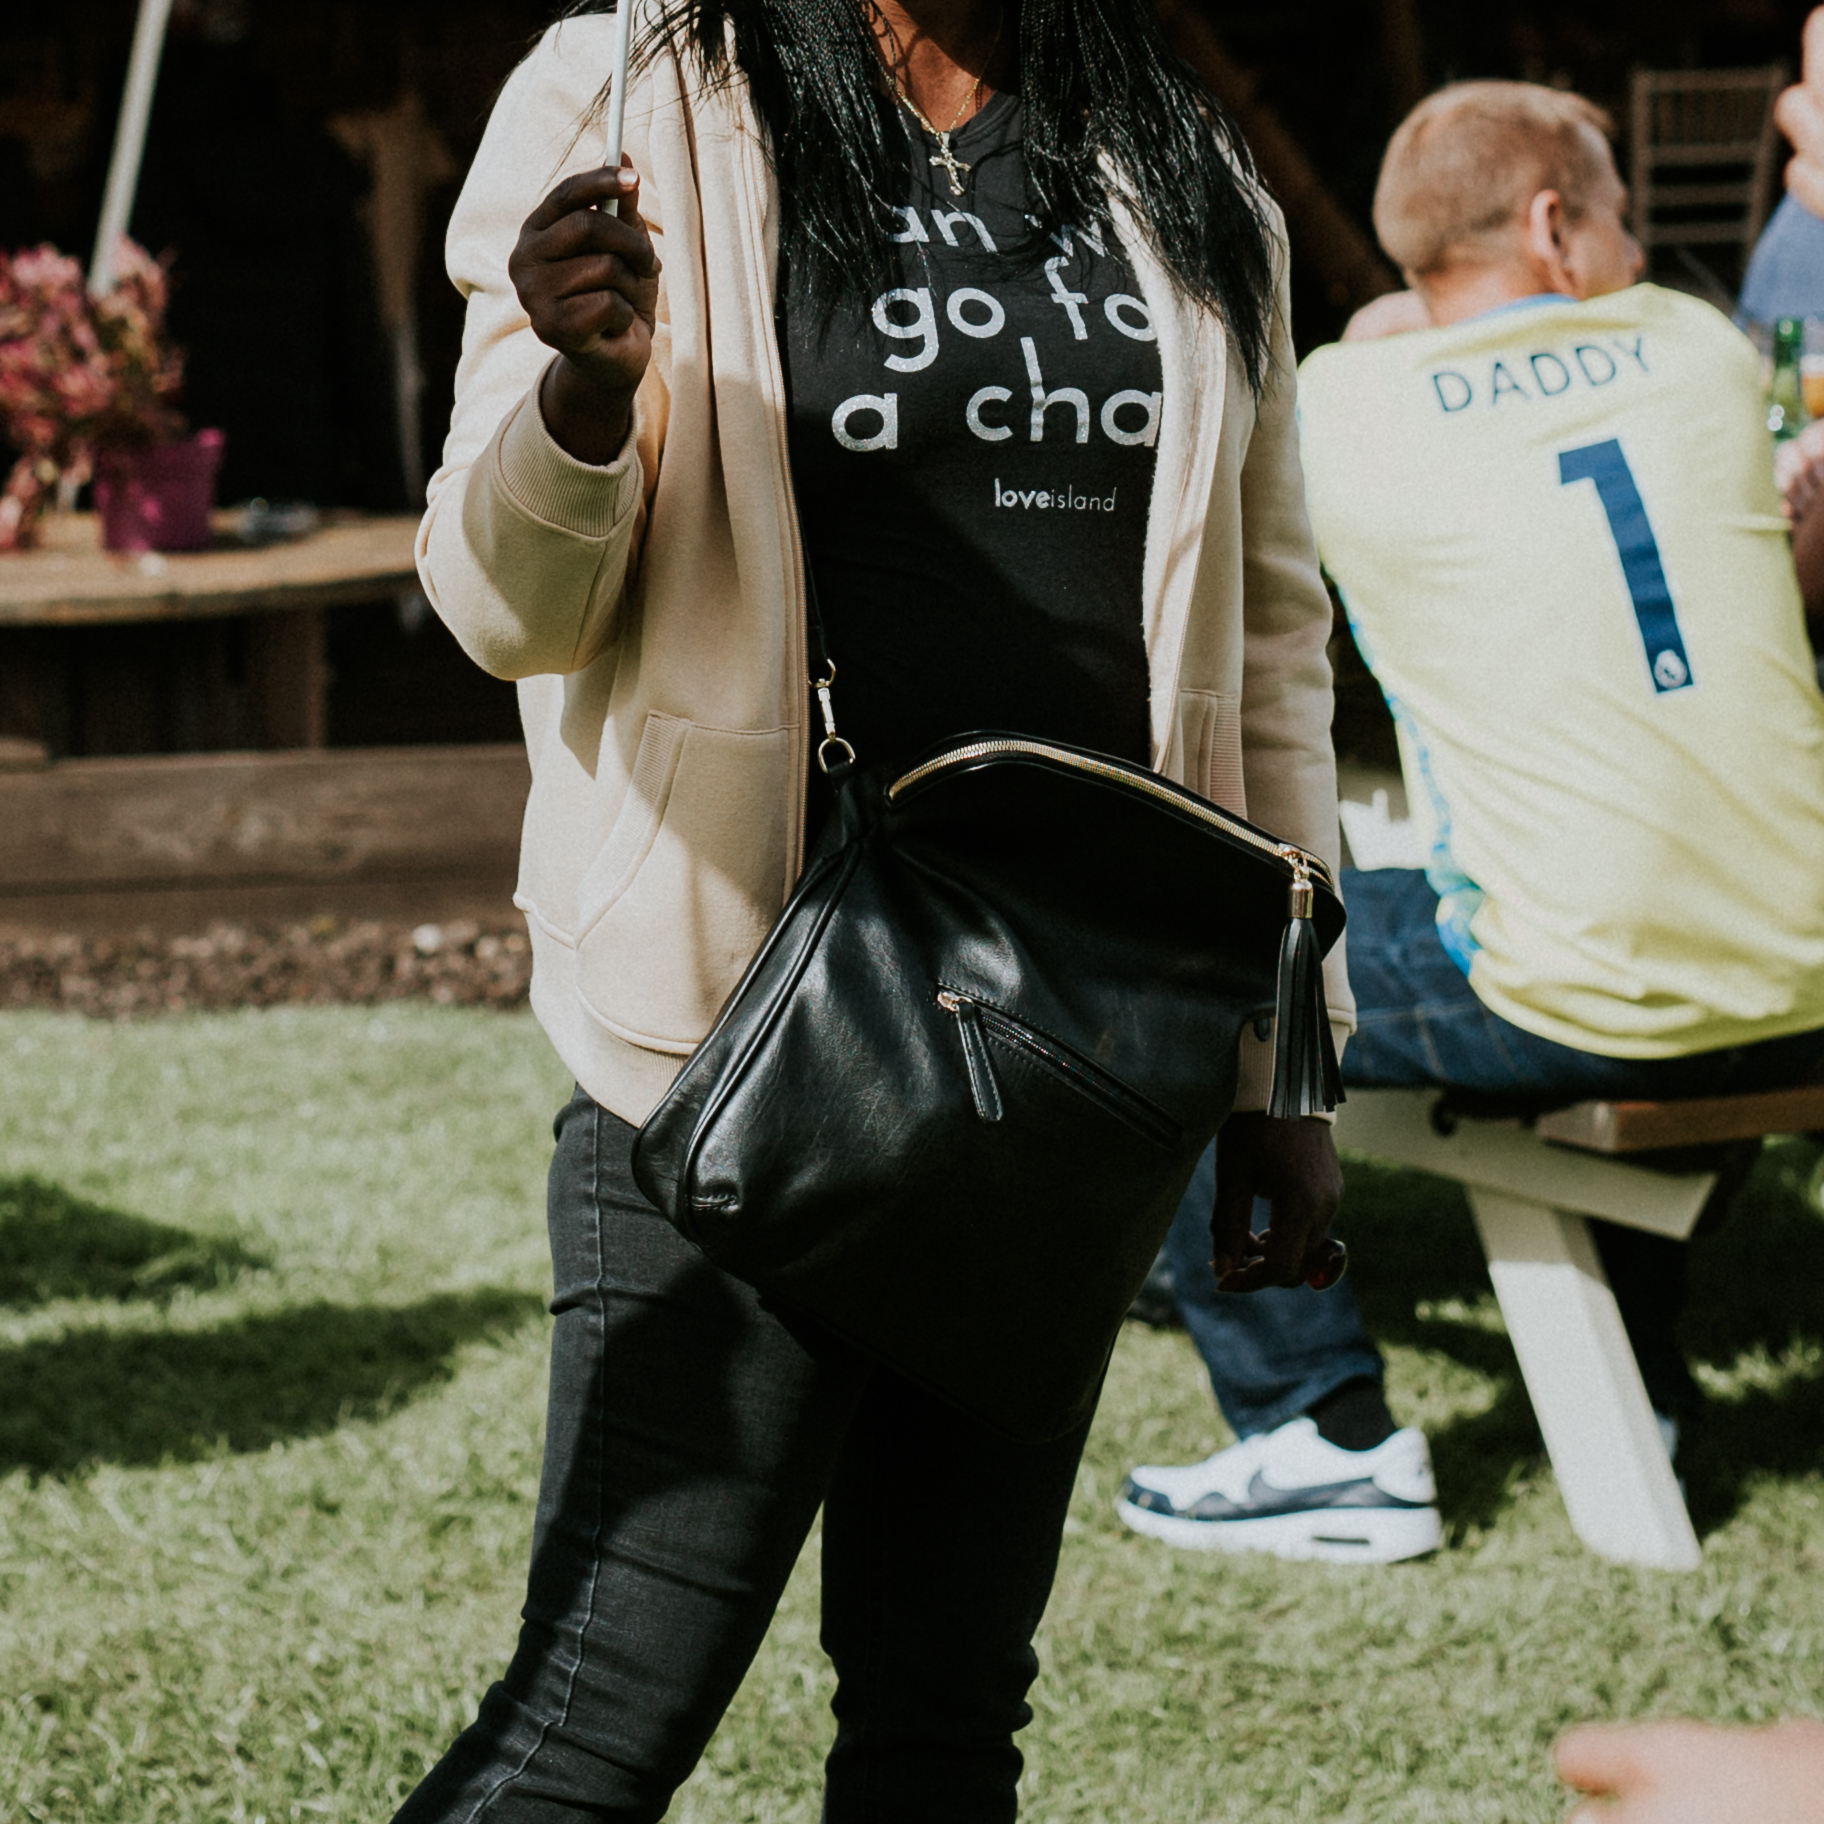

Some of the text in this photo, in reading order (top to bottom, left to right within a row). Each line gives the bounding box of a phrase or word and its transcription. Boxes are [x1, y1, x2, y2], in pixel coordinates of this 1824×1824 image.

[871, 287, 1006, 373] go
[831, 336, 1163, 452] a cha
[1432, 335, 1650, 413] DADDY
[993, 477, 1118, 512] loveisland
[1557, 437, 1694, 694] 1
